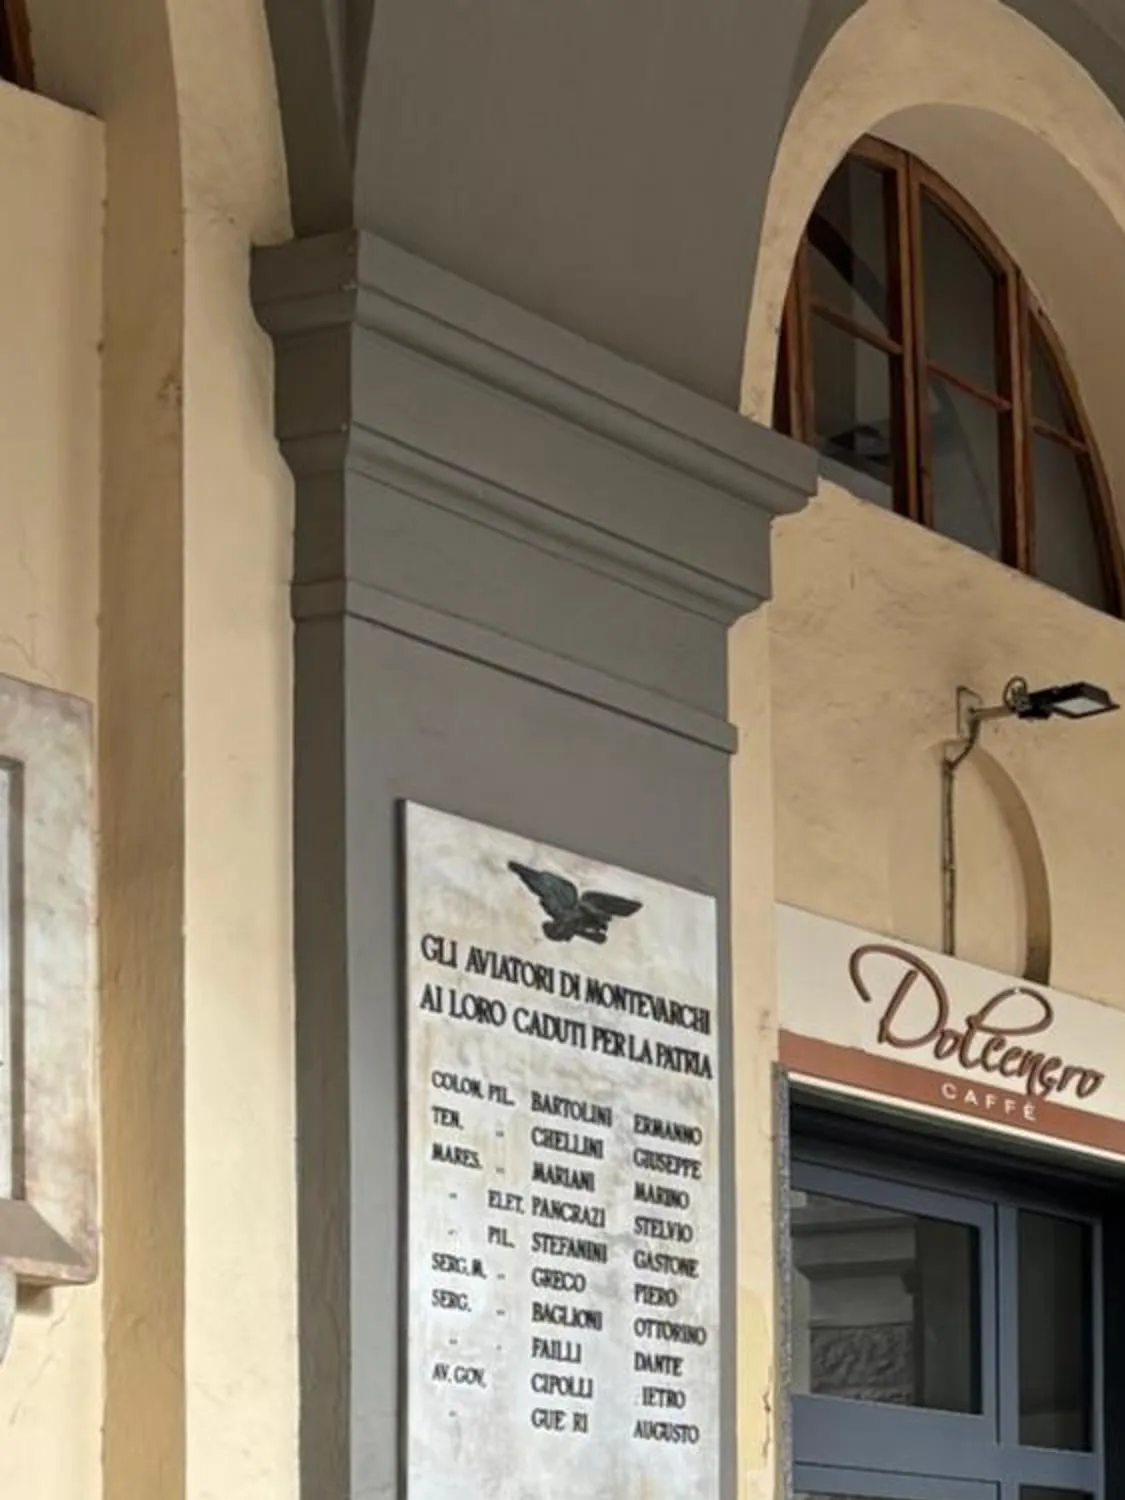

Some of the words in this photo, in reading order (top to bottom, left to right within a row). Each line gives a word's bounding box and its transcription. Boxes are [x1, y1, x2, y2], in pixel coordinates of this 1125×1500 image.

[421, 934, 457, 968] GLI
[465, 945, 554, 993] AVIATORI
[560, 970, 580, 1000] DI
[586, 976, 711, 1035] MONTEVARCHI
[420, 983, 443, 1013] AI
[448, 989, 507, 1027] LORO
[513, 1008, 586, 1049] CADUTI
[592, 1025, 626, 1058] PER
[629, 1034, 654, 1065] LA
[656, 1042, 713, 1079] PATRIA
[531, 1090, 612, 1127] BARTOLINI
[634, 1113, 703, 1146] ERMANNO
[941, 1083, 1037, 1122] CAFFÈ
[531, 1126, 604, 1159] CHELLINI
[634, 1148, 702, 1179] GIUSEPPE
[532, 1161, 595, 1192] MARIANI
[634, 1181, 690, 1210] MARINO
[532, 1196, 606, 1228] PANCRAZI
[635, 1216, 694, 1243] STELVIO
[532, 1232, 608, 1264] STEFANINI
[634, 1250, 699, 1279] GASTONE
[531, 1267, 587, 1293] GRECO
[634, 1283, 678, 1307] PIERO
[532, 1302, 603, 1331] BAGLIONI
[634, 1317, 707, 1346] OTTORINO
[532, 1337, 582, 1364] FAILLI
[634, 1351, 684, 1377] DANTE
[531, 1373, 593, 1399] CIPOLLI
[633, 1419, 700, 1445] AUGUSTO
